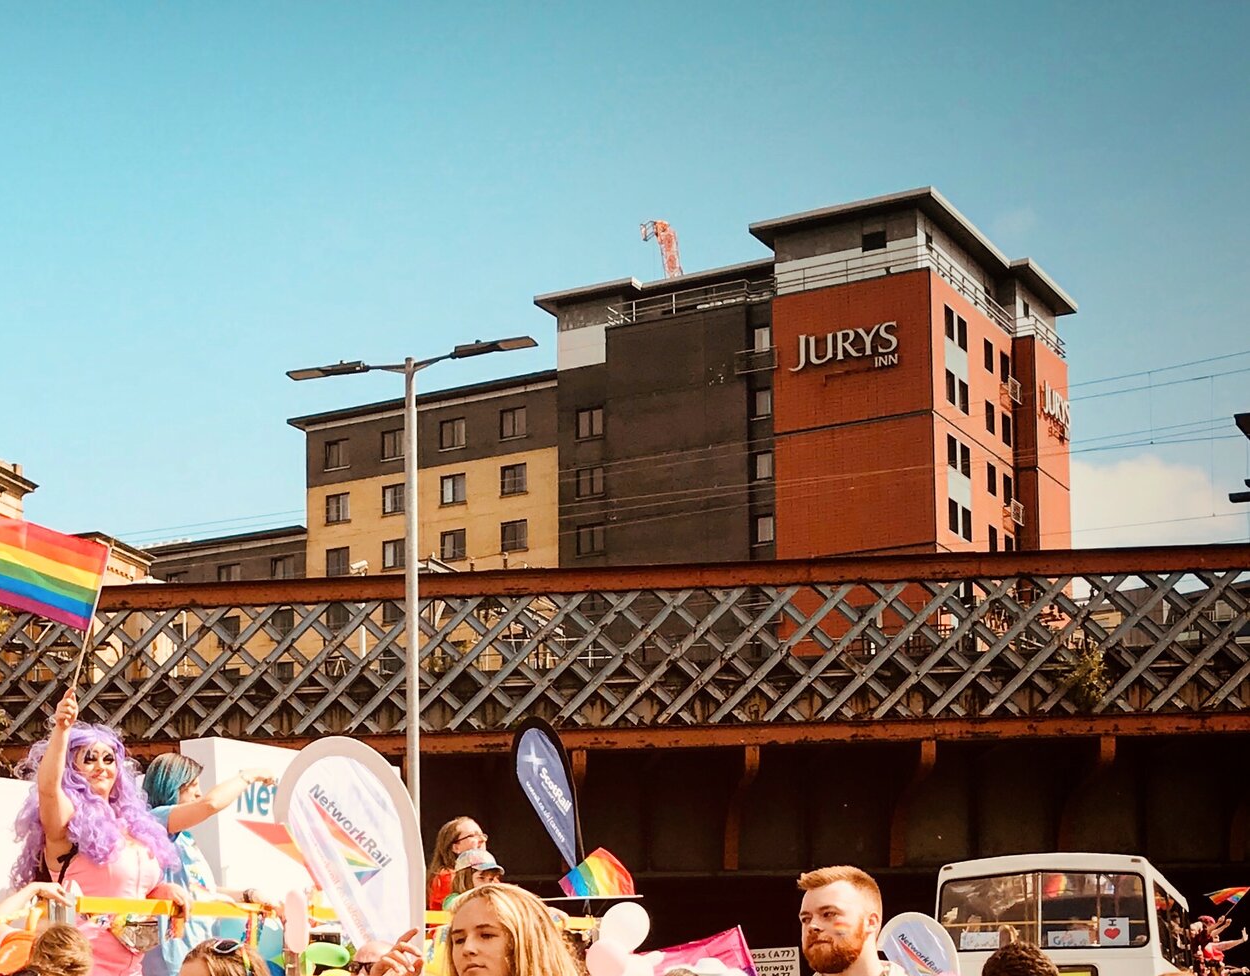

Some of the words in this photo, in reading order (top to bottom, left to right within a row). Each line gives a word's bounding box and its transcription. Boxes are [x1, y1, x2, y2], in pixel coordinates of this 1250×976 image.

[789, 321, 898, 372] JURYS
[874, 353, 899, 369] INN
[236, 778, 279, 816] Net
[539, 767, 573, 813] ScotRail
[308, 783, 393, 869] NetworkRail
[755, 964, 794, 972] otorways
[768, 949, 796, 959] (A77)
[898, 933, 943, 975] NetworkRail
